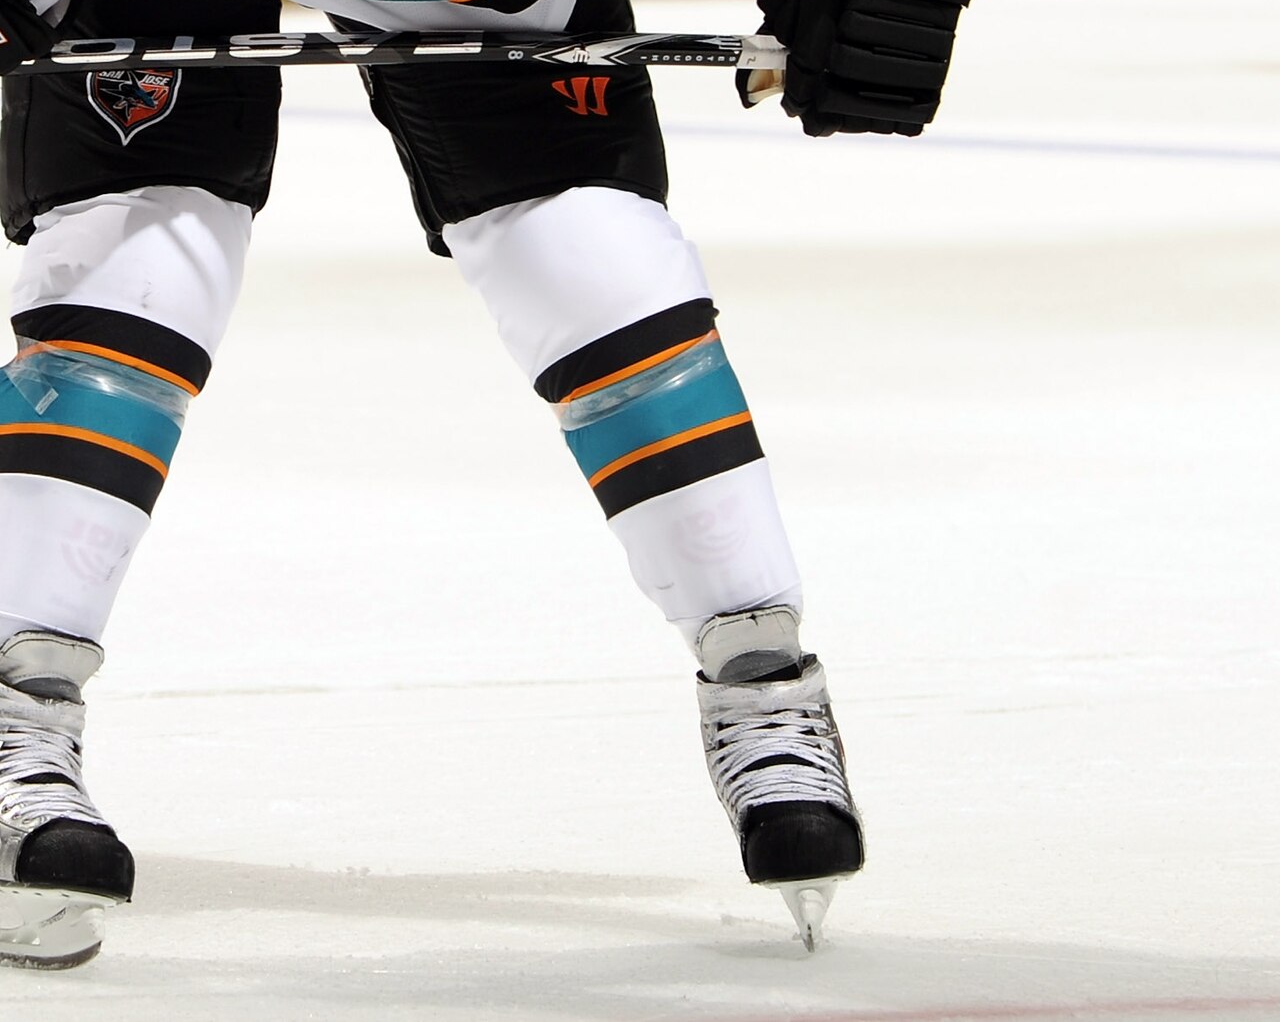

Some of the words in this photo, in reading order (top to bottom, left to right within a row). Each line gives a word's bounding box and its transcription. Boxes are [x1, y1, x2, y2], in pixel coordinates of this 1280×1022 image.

[20, 31, 484, 65] EASTO
[640, 54, 736, 62] SETOGUCHI
[141, 74, 171, 86] JOSE
